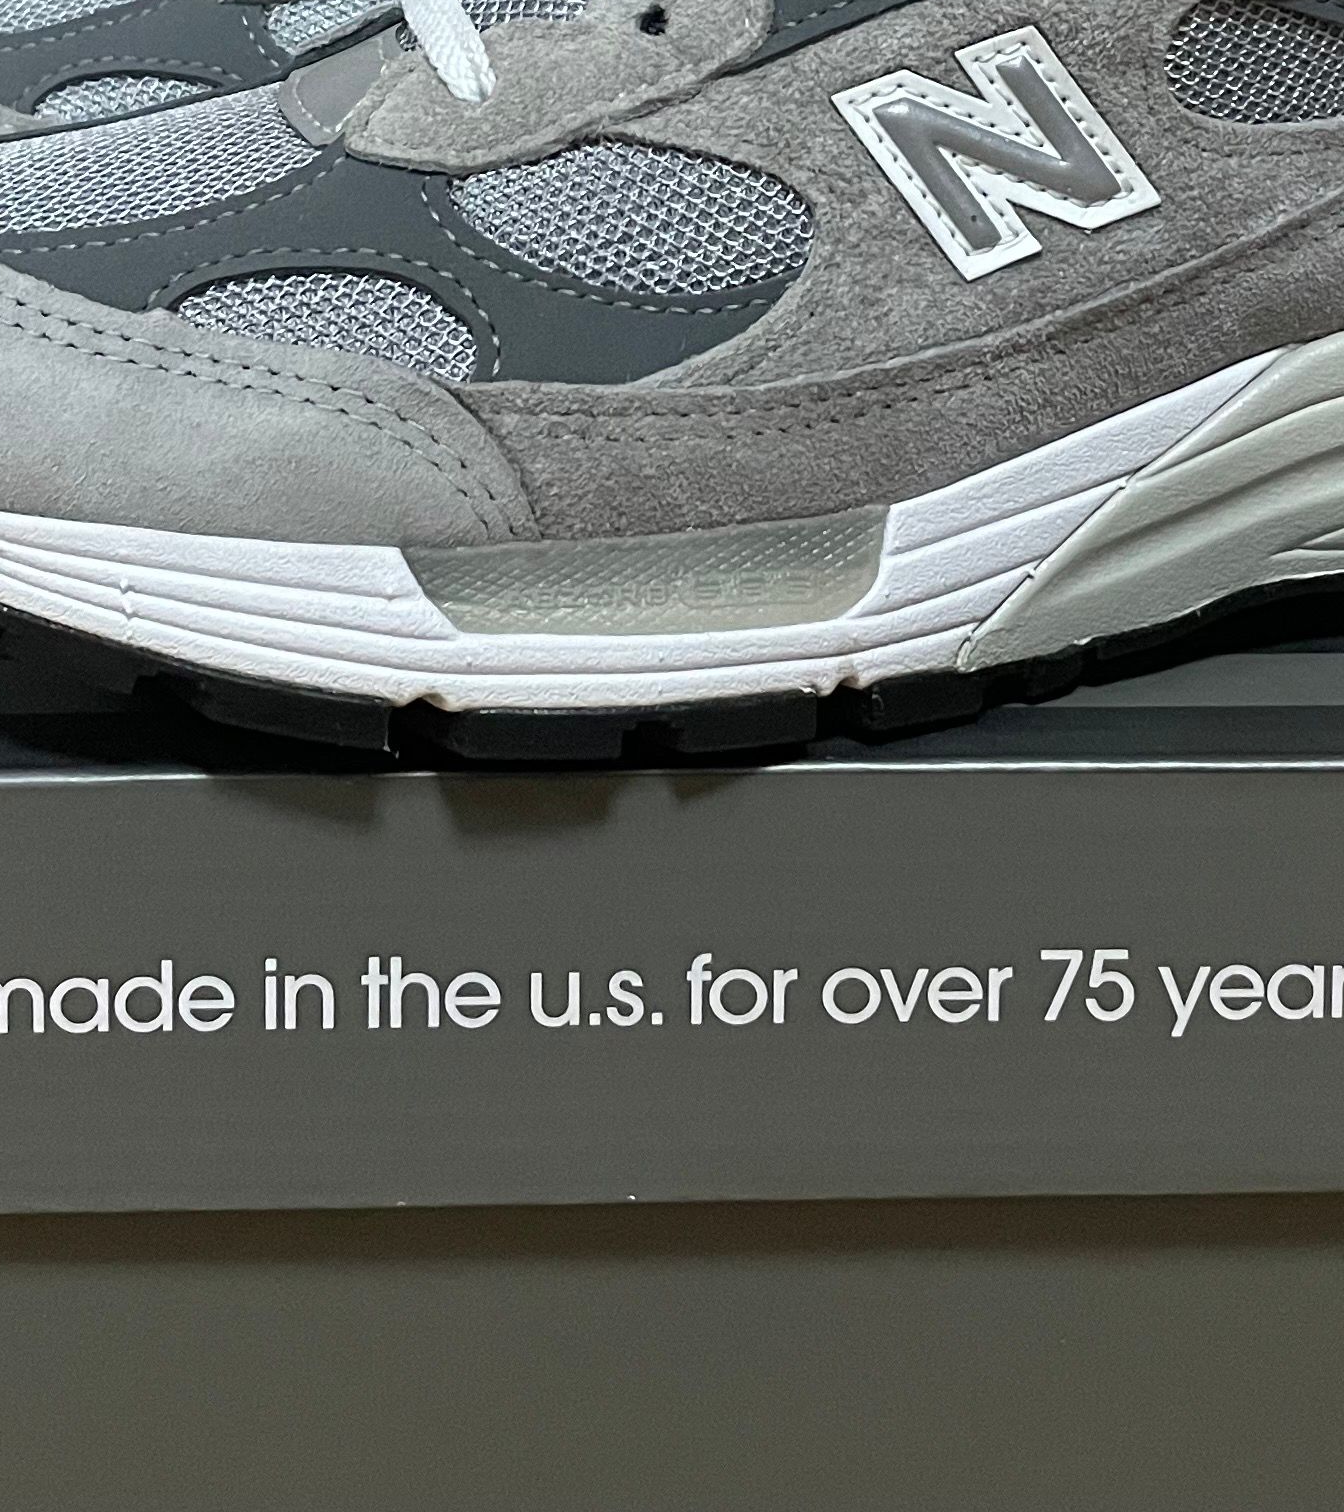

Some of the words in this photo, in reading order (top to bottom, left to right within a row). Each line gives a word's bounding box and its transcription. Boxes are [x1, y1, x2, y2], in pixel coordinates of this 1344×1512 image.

[831, 25, 1162, 283] N
[264, 958, 335, 1031] in
[360, 956, 501, 1029] the
[530, 971, 663, 1028] u.s.
[686, 952, 798, 1025] for
[822, 966, 1013, 1025] over
[1040, 948, 1135, 1022] 75
